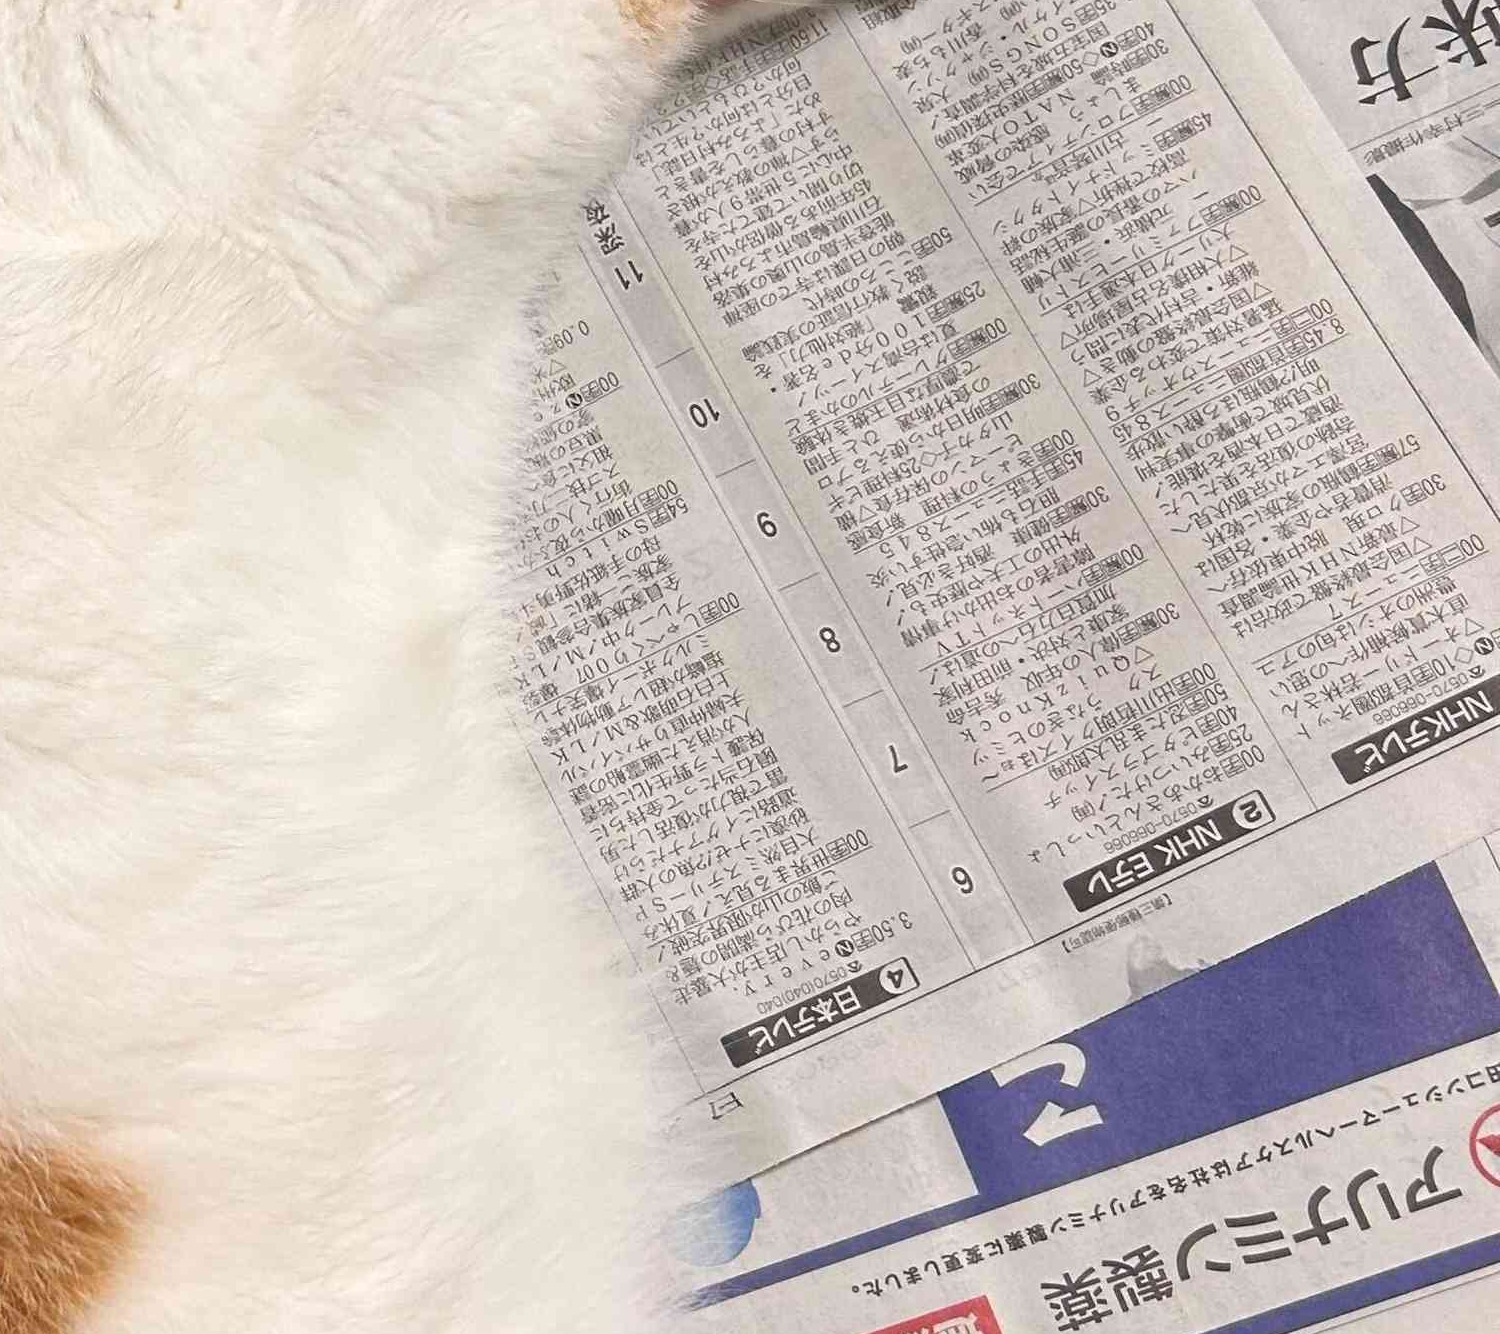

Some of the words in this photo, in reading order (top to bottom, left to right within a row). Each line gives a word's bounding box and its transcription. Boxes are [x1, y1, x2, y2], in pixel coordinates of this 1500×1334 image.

[653, 105, 833, 202] す村の暮らしを書きと
[951, 120, 1051, 187] 感染の脅威
[576, 194, 625, 256] 深夜
[681, 158, 864, 256] 切り開いて建てた寺を
[700, 193, 883, 292] 石川県輪島市よろみ村
[1006, 165, 1199, 276] ハマの番長の誕生秘話
[612, 257, 644, 290] 11
[709, 211, 895, 310] 能登半島の山奥の集落
[719, 228, 905, 328] 朝の日課は寺での座禅
[1061, 221, 1233, 321] 大リーグ日本選手は
[739, 263, 927, 364] 説く教行信証の実践論
[1065, 258, 1258, 367] 維新・吉村代表に問う
[1086, 294, 1283, 407] 猛暑対策で変わる企業
[685, 394, 720, 431] 10
[789, 353, 981, 458] で濃厚な目玉焼き体験
[802, 426, 880, 476] ひと手間
[1132, 372, 1331, 482] 伏見城で衝撃の事実判
[1156, 410, 1355, 520] 奇跡の復活を果たした
[1167, 430, 1369, 540] 宮澤エマが京都伏見へ
[752, 509, 778, 541] 9
[842, 509, 905, 552] 新食感
[865, 485, 1060, 589] 胆石も怖い急性すい炎
[1191, 470, 1392, 580] 消費者や企業・各国は
[815, 623, 841, 655] 8
[897, 541, 1095, 648] 障害者のお出かけ事情
[1254, 571, 1456, 682] 豊洲のオシは旬のアユ
[530, 630, 710, 728] ミルクボーイ爆笑ナレ
[931, 600, 1130, 708] 家康と対決・前田利家
[1266, 592, 1469, 701] 直木賞候補作への思い
[557, 686, 744, 787] 夫婦仲直りサバイバル
[566, 706, 753, 806] 人が消えた幽霊船の謎
[943, 686, 1004, 728] 秀吉命
[966, 688, 1103, 767] うなぎのヒミツ
[1353, 686, 1493, 773] NHKテレビ
[576, 724, 767, 826] 保護トラ野生化に密着
[587, 744, 776, 845] 隕石当たって金持ちに
[883, 742, 908, 773] 7
[597, 764, 787, 865] 雷で視力が復活した男
[609, 783, 798, 885] 道路にイグアナだらけ
[1153, 815, 1222, 867] NHK
[948, 863, 975, 896] 6
[1081, 848, 1153, 900] Eテレ
[669, 904, 863, 1007] やらかし店主が大暴走
[744, 983, 861, 1055] 日本テレビ
[989, 1031, 1112, 1156] こ
